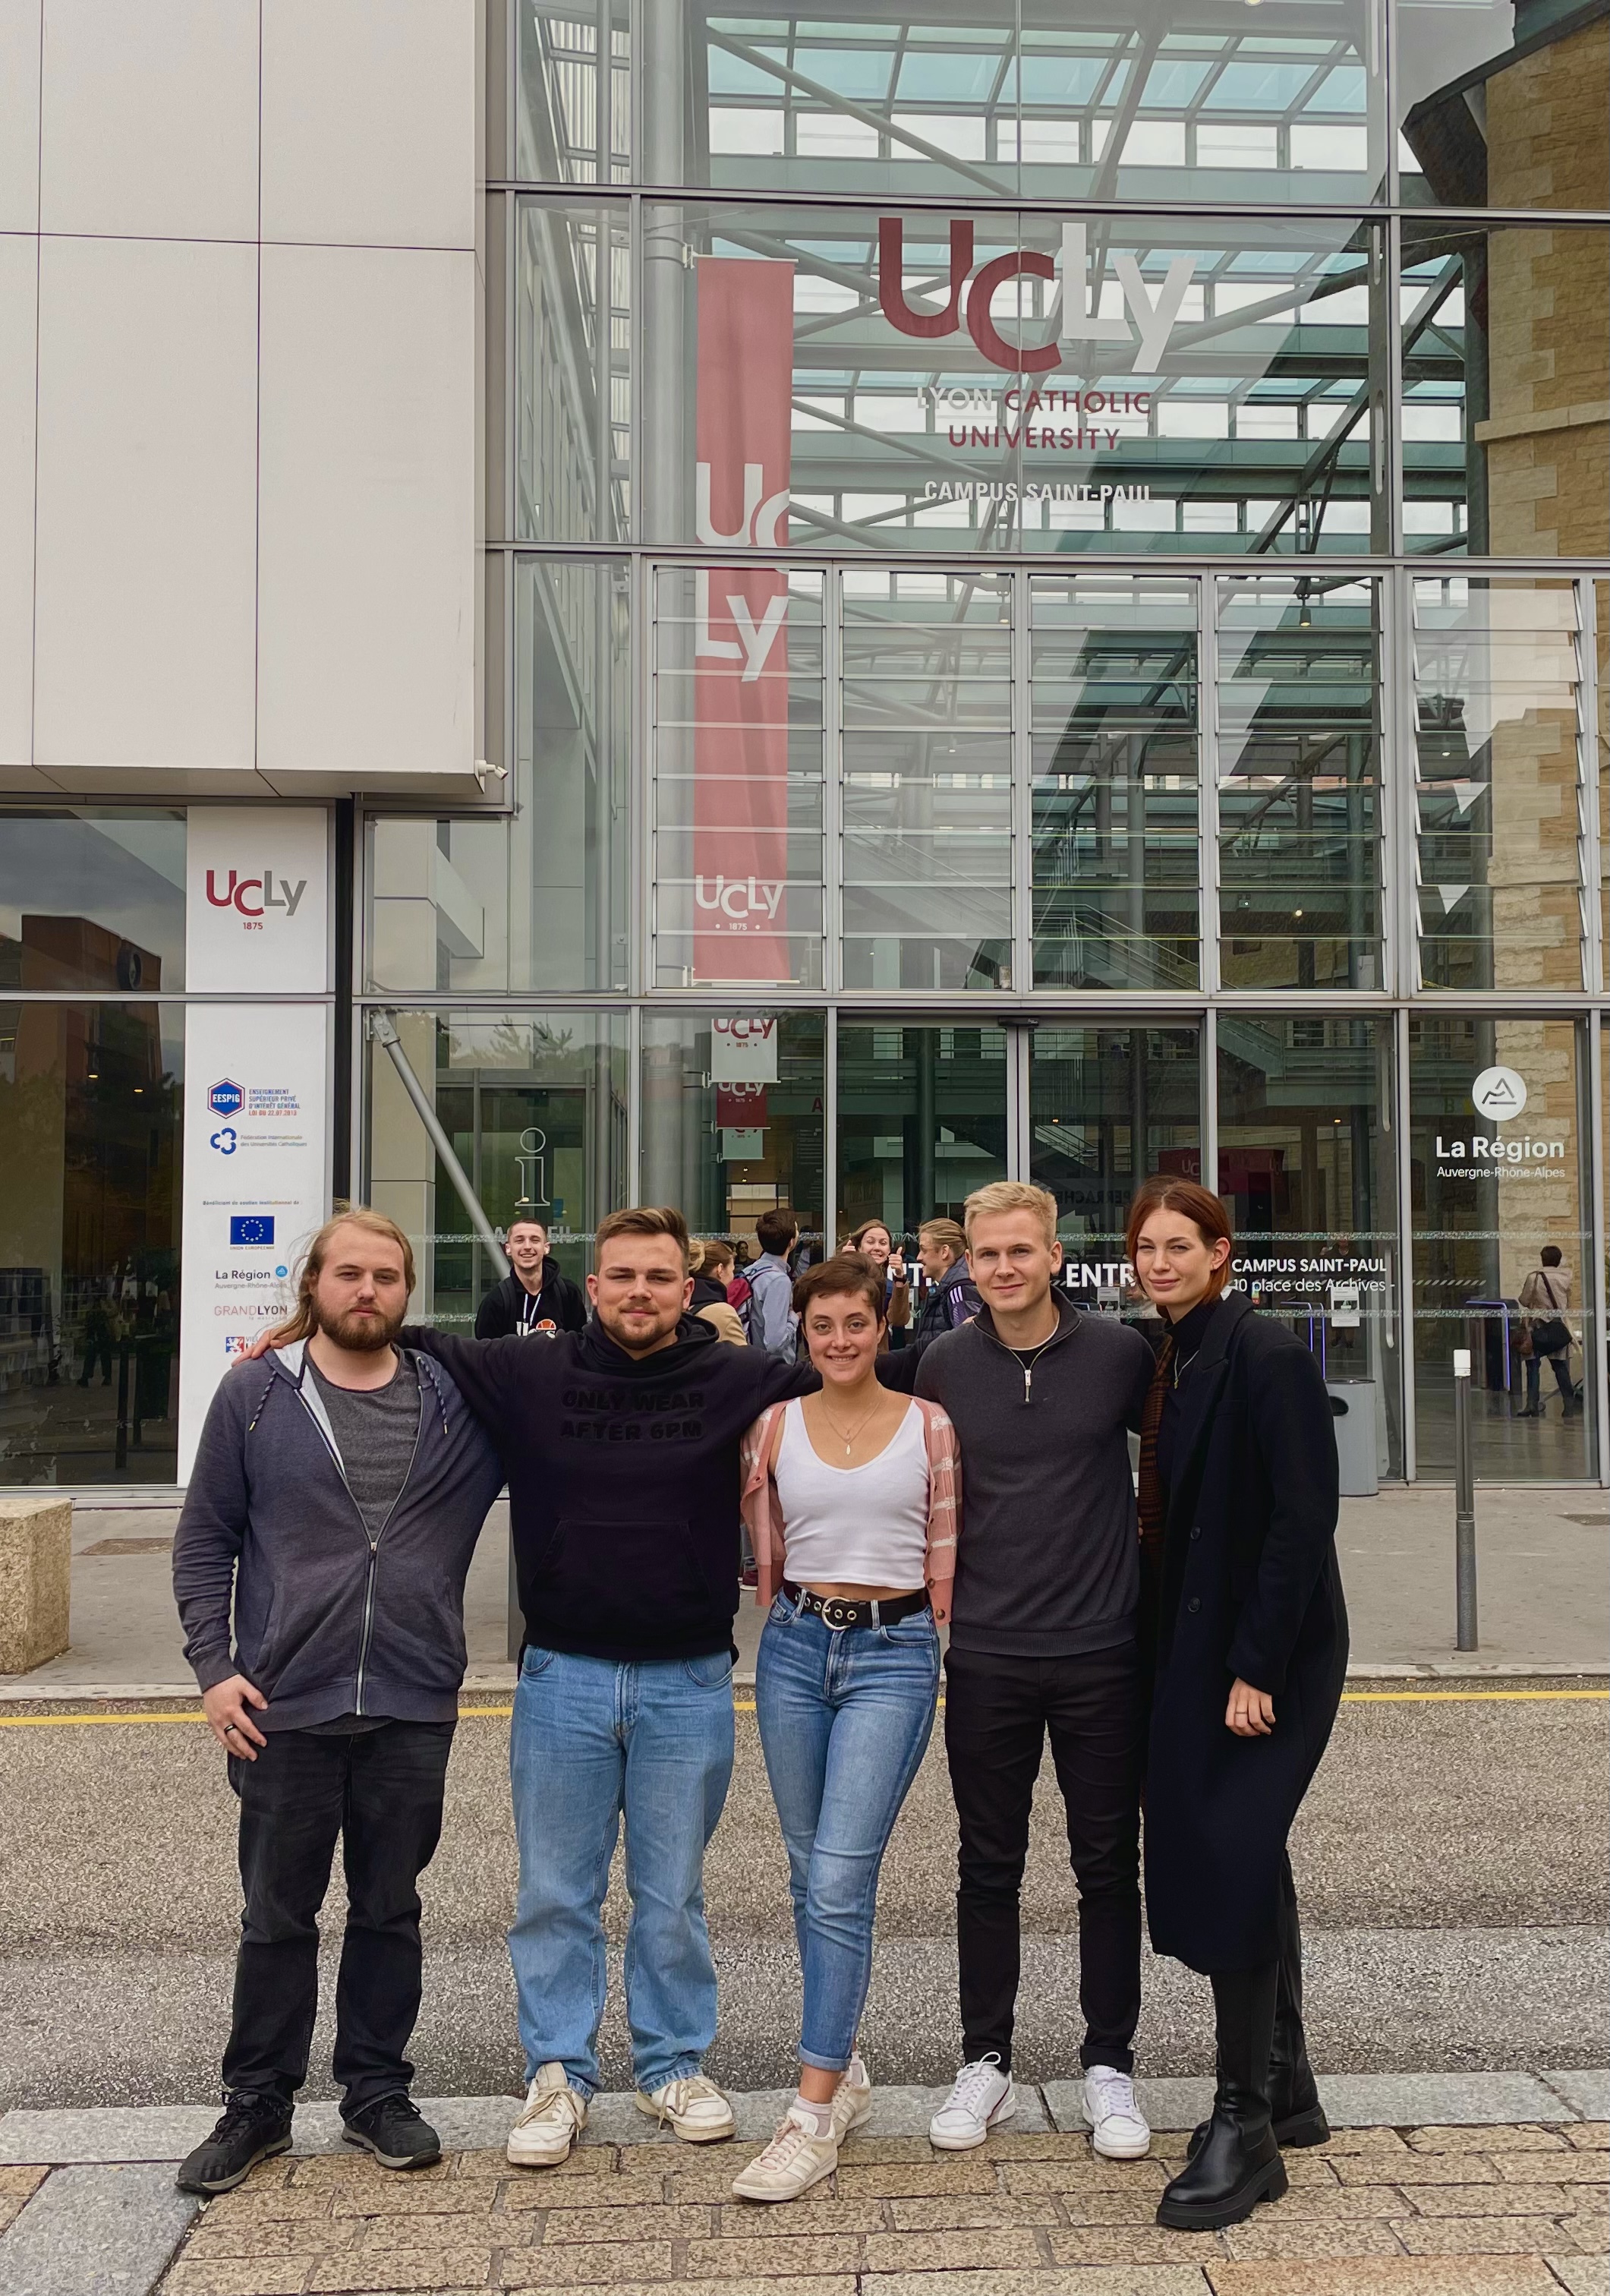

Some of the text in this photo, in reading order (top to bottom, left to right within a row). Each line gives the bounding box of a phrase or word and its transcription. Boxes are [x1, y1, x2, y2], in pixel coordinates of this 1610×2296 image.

[878, 217, 1197, 373] UCLy
[917, 386, 1152, 414] LYON CATHOLIC
[949, 424, 1120, 450] UNIVERSITY
[924, 481, 1155, 504] CAMPUS SAINT-PAUL
[206, 869, 307, 916] UCLy
[695, 875, 784, 919] UCLy
[242, 922, 263, 930] 1875
[729, 922, 748, 931] 1875
[213, 1094, 240, 1103] EESPIG
[1435, 1136, 1565, 1162] La Région
[1436, 1167, 1565, 1180] Auvergne-Rhône-Alpes
[216, 1269, 271, 1281] La Région
[1232, 1258, 1388, 1273] CAMPUS SAINT-PAUL
[1254, 1278, 1292, 1295] place
[1295, 1278, 1322, 1292] des
[1325, 1277, 1386, 1292] Archives
[561, 1386, 705, 1411] ONLY WEAR
[559, 1418, 704, 1441] AFTER 6PM
